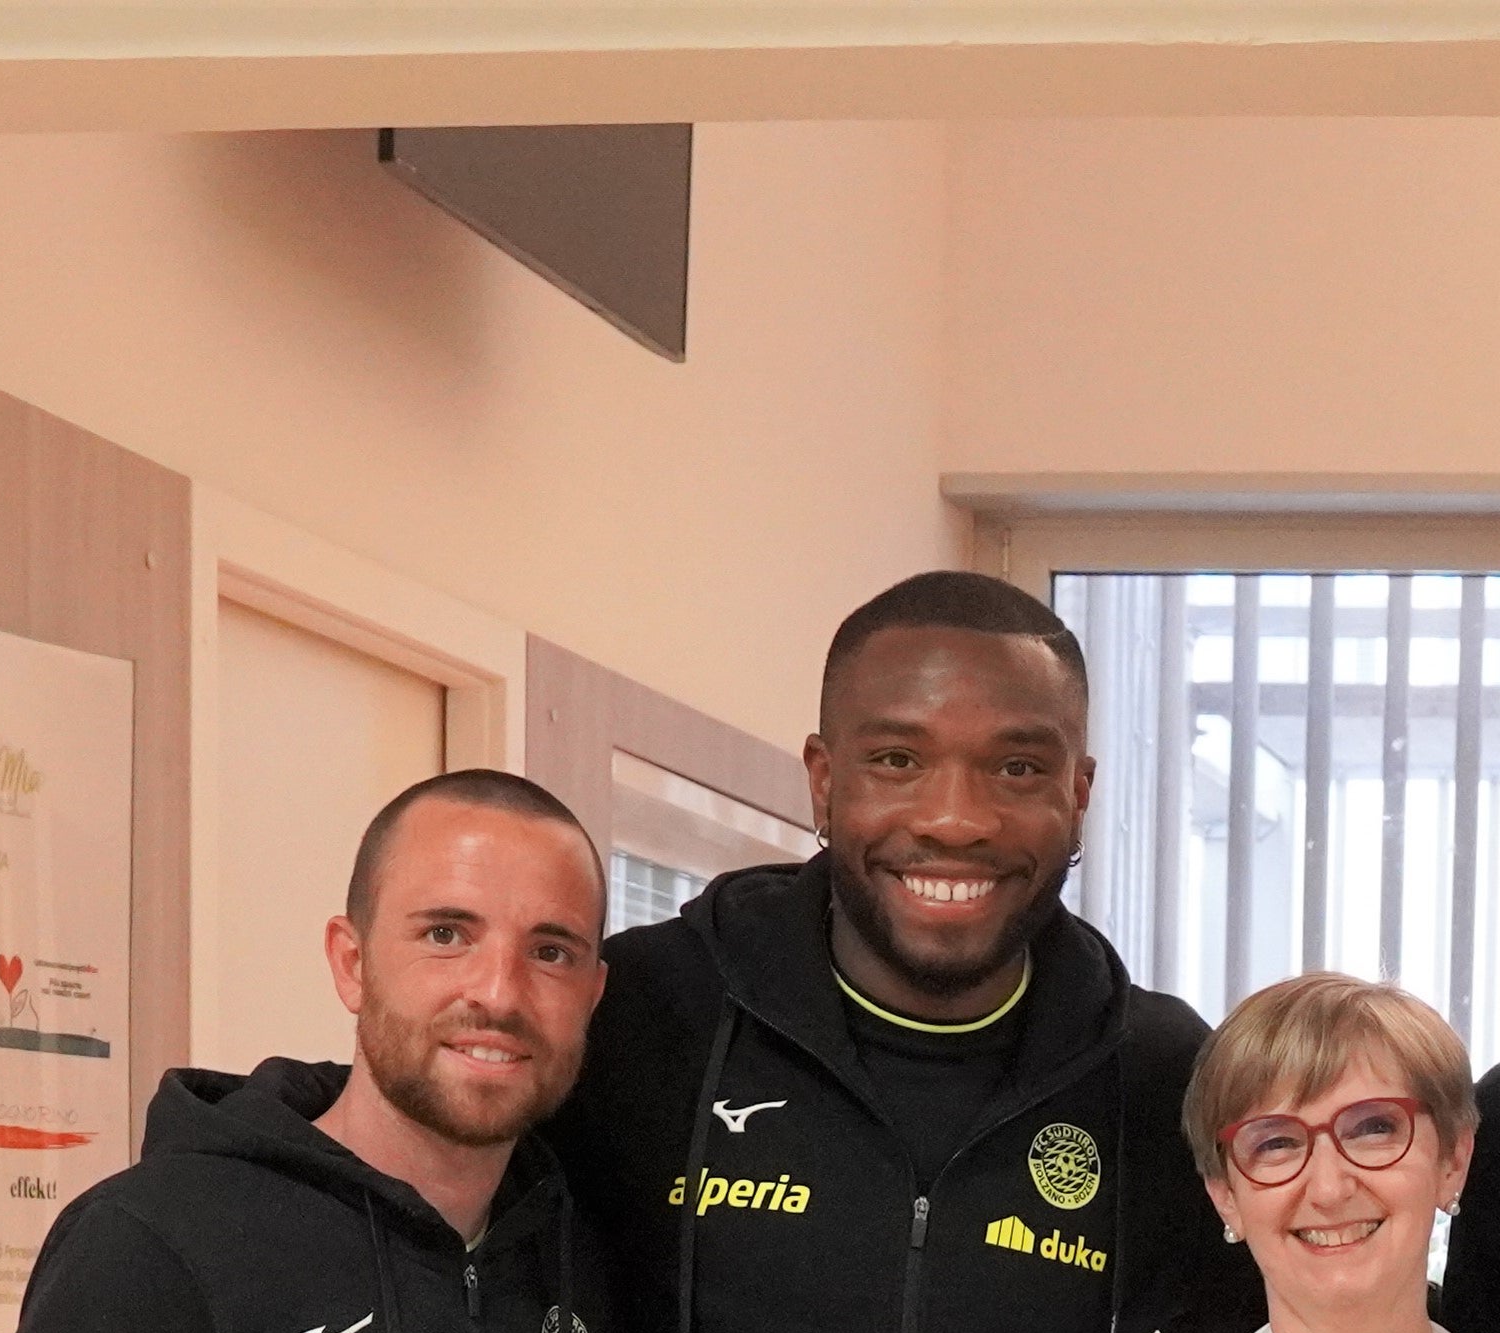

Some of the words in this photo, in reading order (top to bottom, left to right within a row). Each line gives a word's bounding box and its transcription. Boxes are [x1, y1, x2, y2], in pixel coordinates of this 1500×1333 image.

[1034, 1136, 1048, 1154] FC
[1046, 1126, 1098, 1166] SÜDTIROL
[10, 1176, 57, 1200] effekt!
[669, 1168, 810, 1217] alperia
[1033, 1163, 1065, 1205] BOLZANO
[1074, 1175, 1096, 1204] BOZEN
[1040, 1228, 1107, 1273] duka
